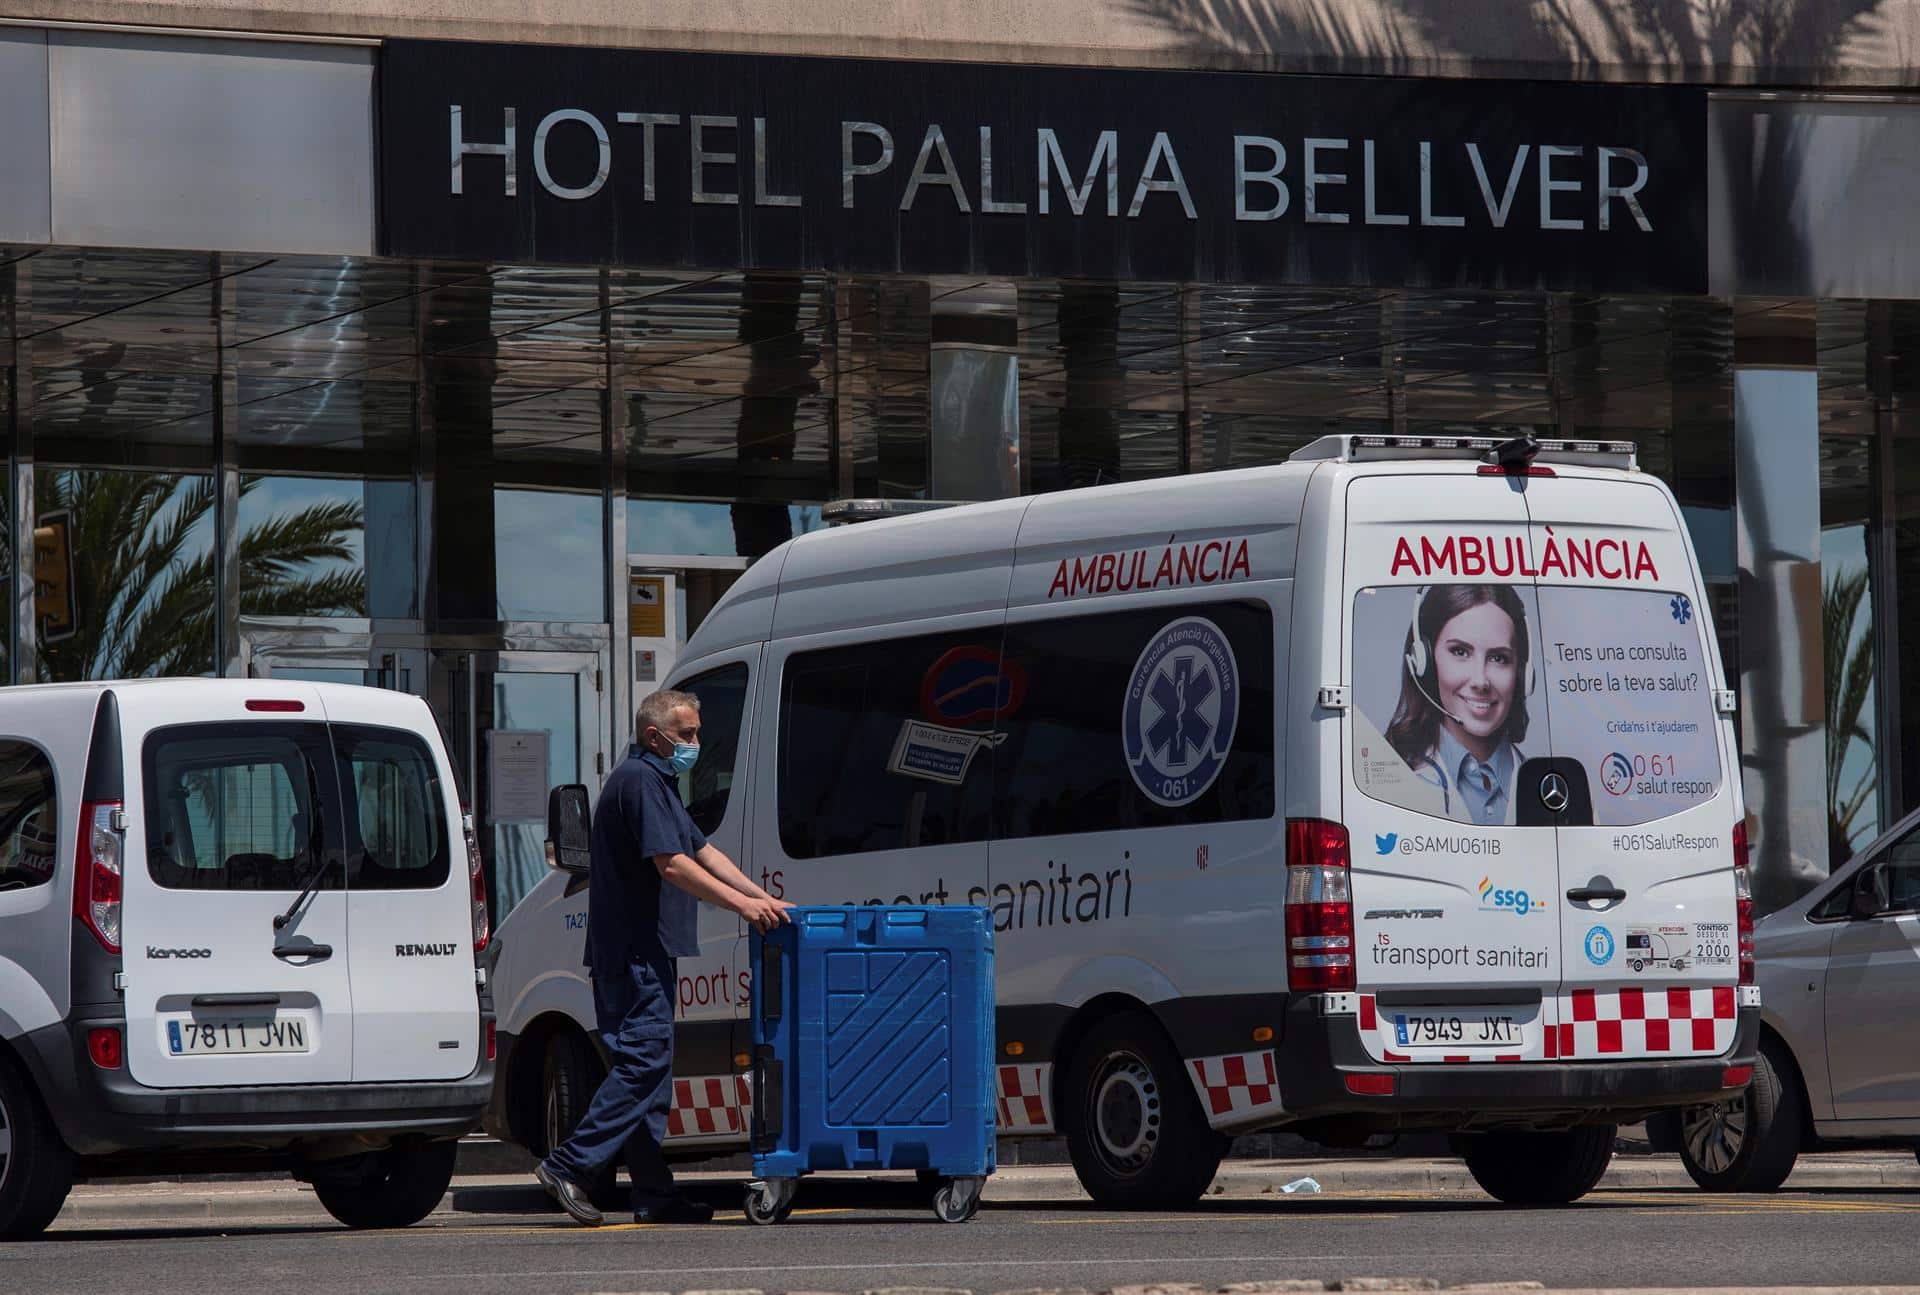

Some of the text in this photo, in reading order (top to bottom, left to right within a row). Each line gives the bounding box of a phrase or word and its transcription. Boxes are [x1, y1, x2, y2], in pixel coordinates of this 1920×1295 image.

[450, 104, 1654, 232] HOTEL PALMA BELLVER
[1391, 525, 1659, 582] AMBULÀNCIA
[1048, 533, 1251, 599] AMBULÁNCIA
[1554, 641, 1688, 662] Tens una consulta
[1559, 672, 1698, 693] sobre la teva salut?
[1606, 720, 1644, 734] Crida'ns
[1162, 777, 1189, 798] 061
[1636, 776, 1713, 798] salut respon
[1399, 835, 1502, 855] @SAMU061IB
[1613, 834, 1718, 852] #061SalutRespon
[564, 911, 588, 931] TA21
[1696, 923, 1729, 932] CONTIGO
[1377, 931, 1390, 946] ts
[395, 943, 457, 957] RENAULT
[1372, 944, 1549, 970] transport sanitari
[1696, 944, 1730, 957] 2000
[184, 1023, 247, 1049] 7811
[259, 1021, 304, 1047] JVN
[1408, 1017, 1464, 1042] 7949
[1479, 1016, 1513, 1041] JXT
